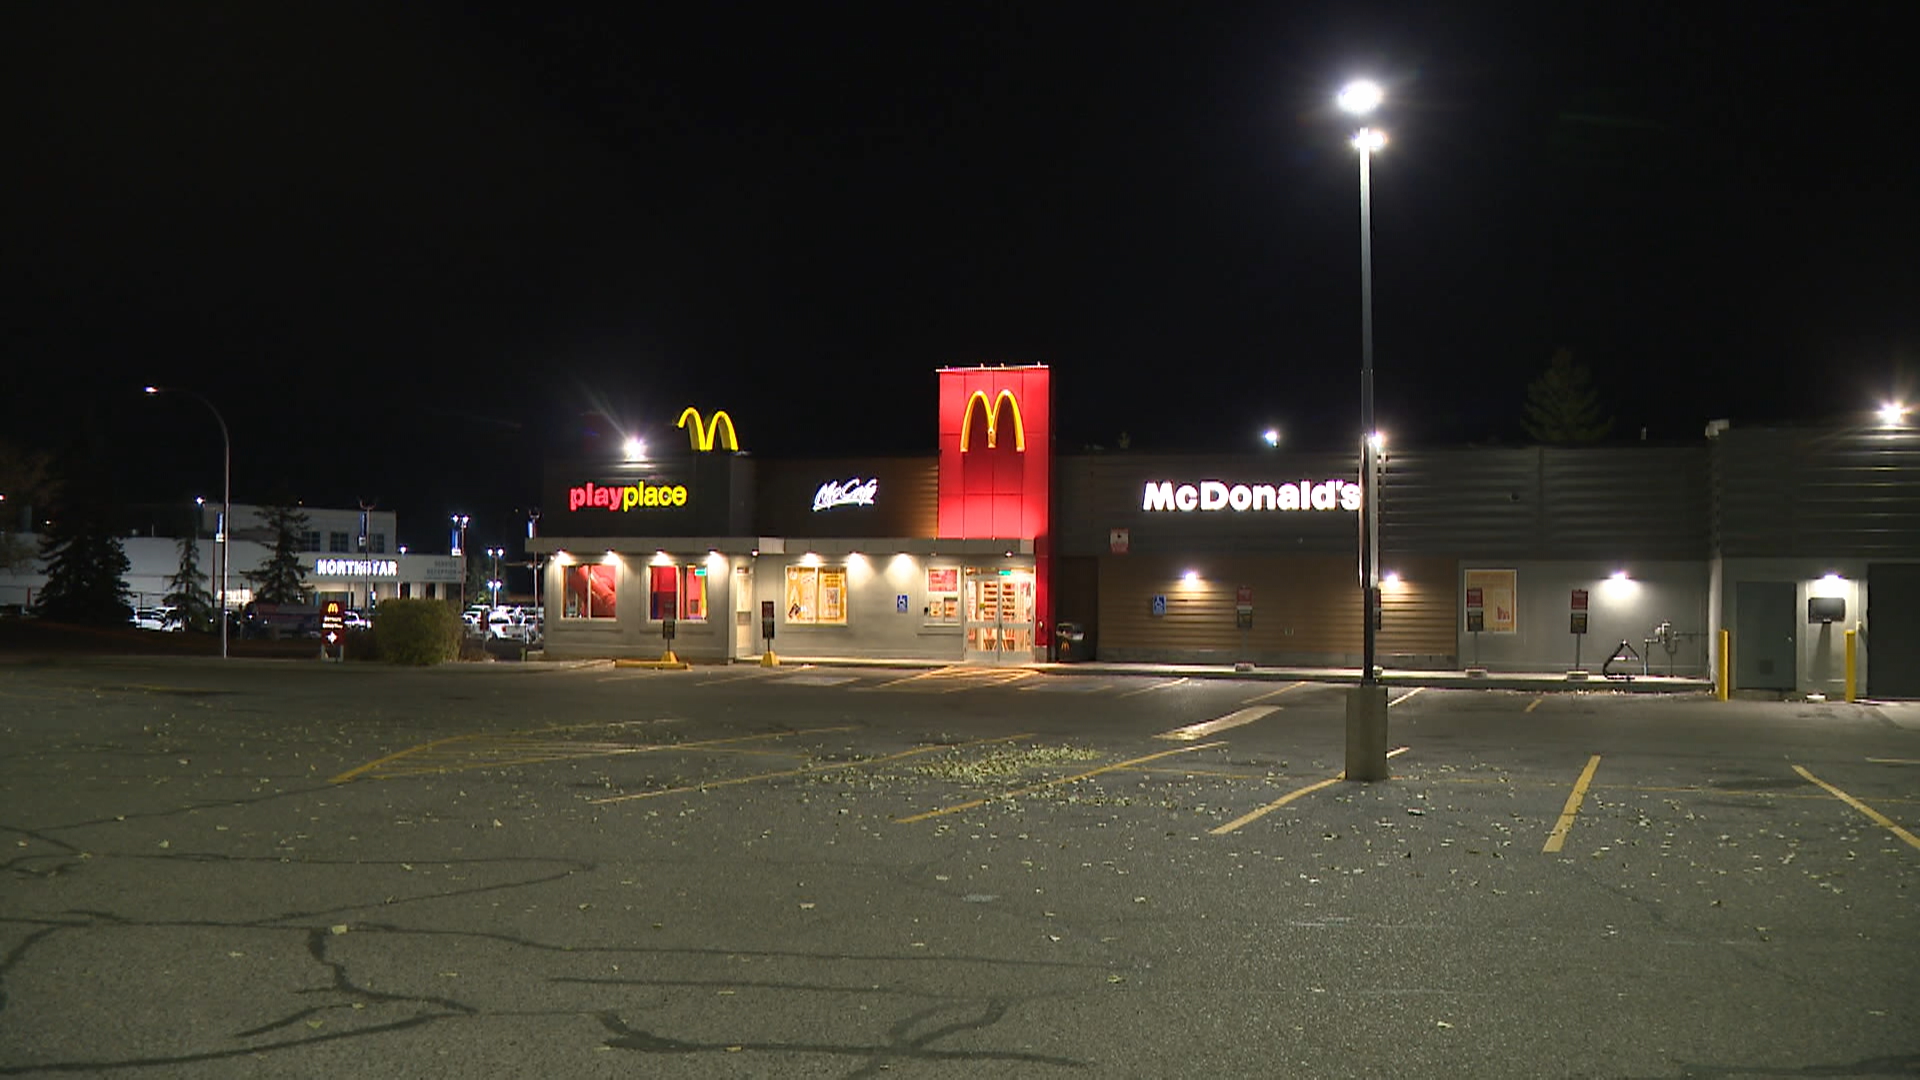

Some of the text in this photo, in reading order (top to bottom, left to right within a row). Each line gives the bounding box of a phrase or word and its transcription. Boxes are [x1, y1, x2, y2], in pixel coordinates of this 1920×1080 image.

[569, 481, 687, 512] playplace
[1143, 480, 1361, 511] McDonald's
[316, 559, 398, 576] NORTHSTAR
